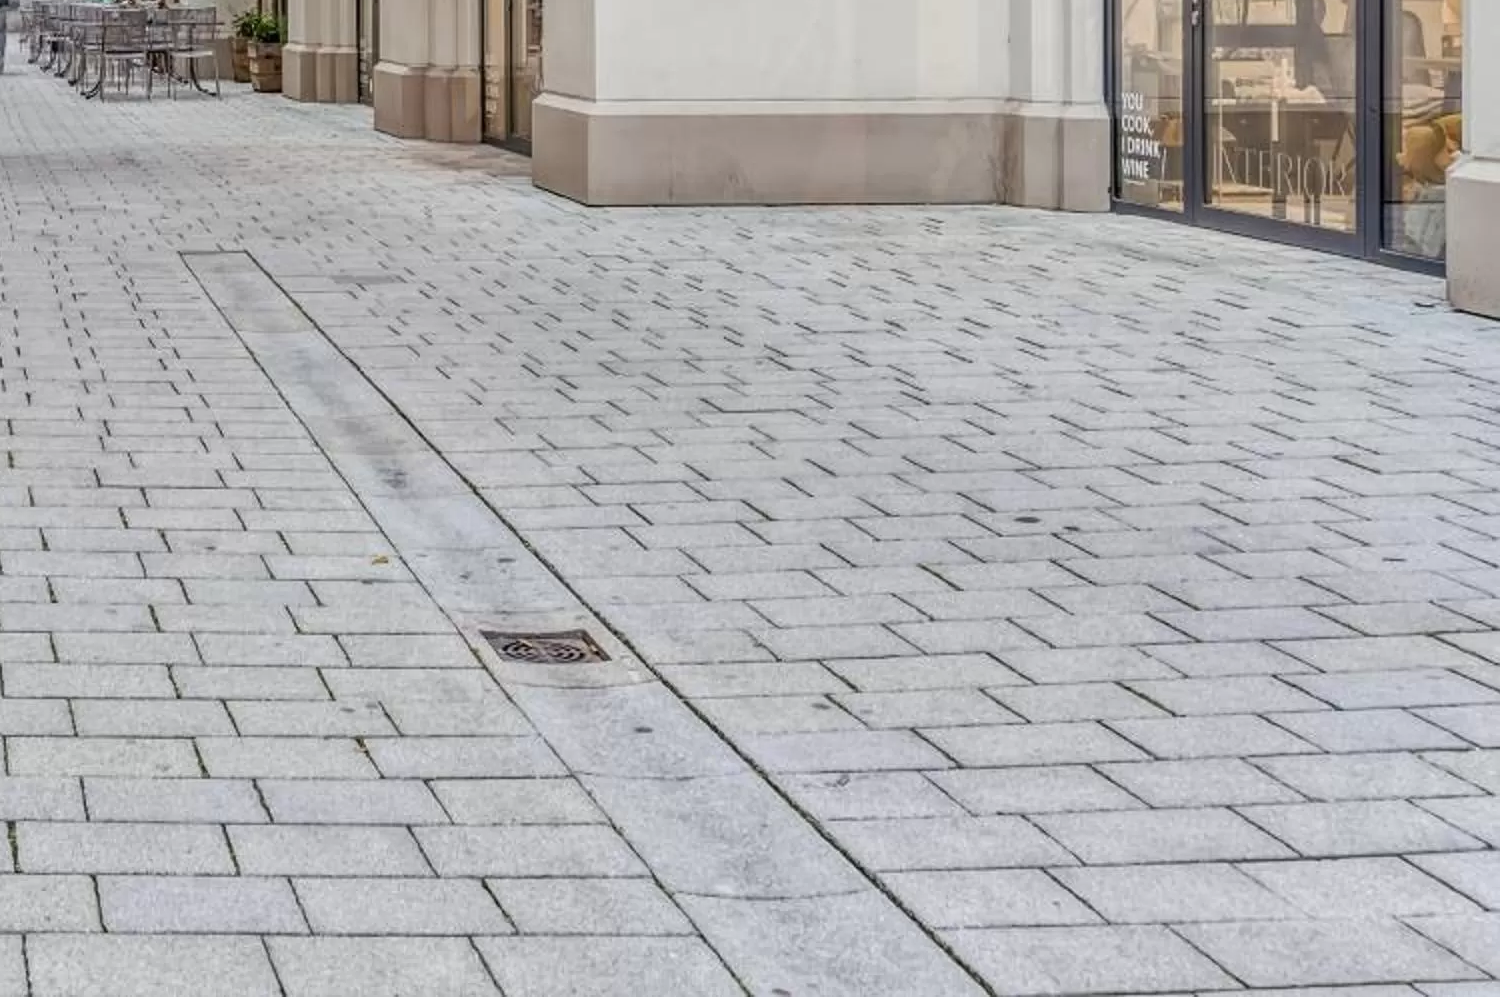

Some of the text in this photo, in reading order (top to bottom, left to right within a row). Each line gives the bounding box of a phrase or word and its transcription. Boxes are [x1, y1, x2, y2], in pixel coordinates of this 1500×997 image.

[1121, 92, 1143, 110] YOU
[1121, 158, 1149, 179] WINE
[1213, 144, 1348, 197] INTERIOR
